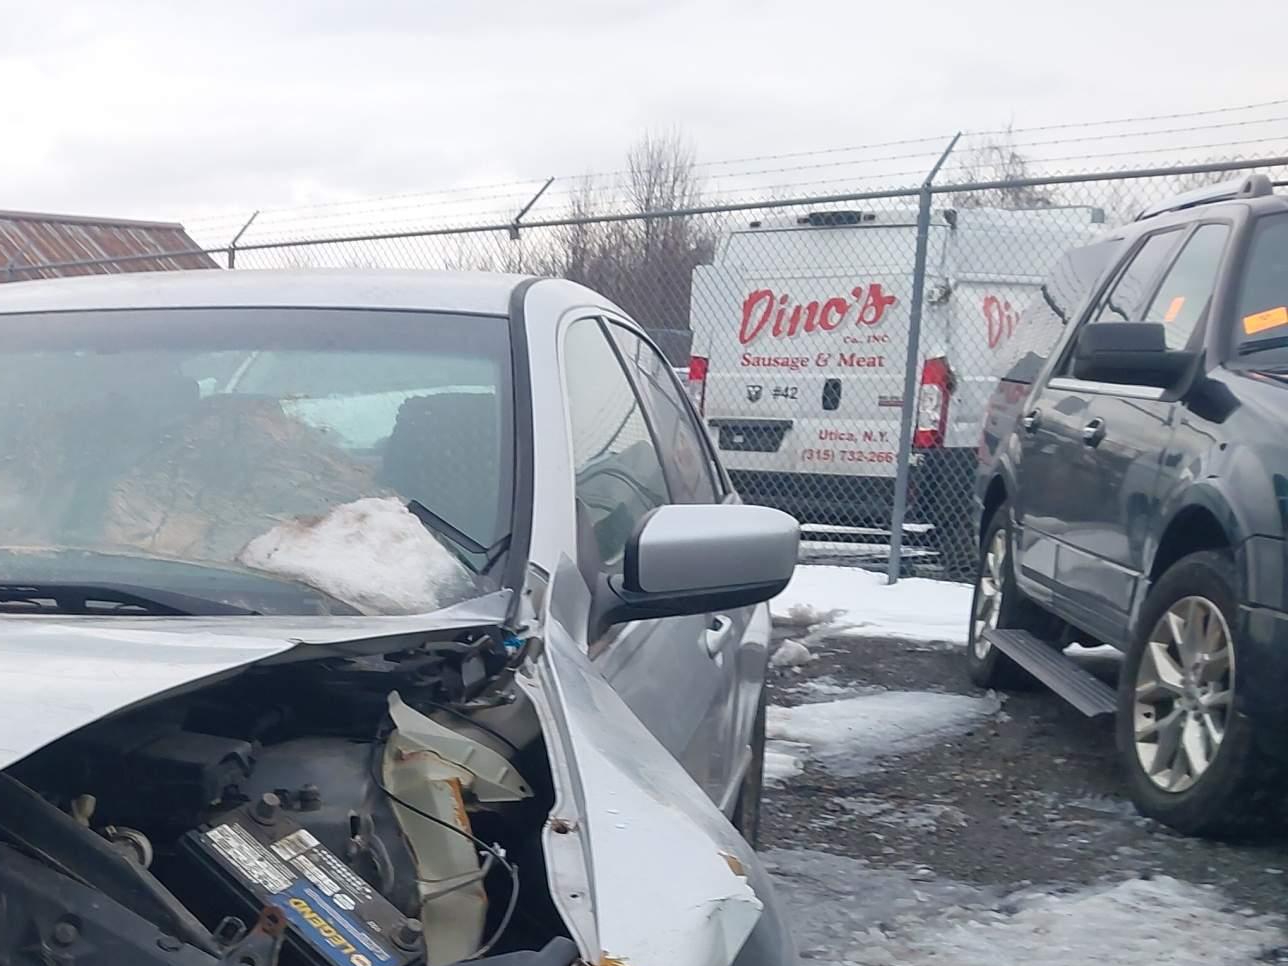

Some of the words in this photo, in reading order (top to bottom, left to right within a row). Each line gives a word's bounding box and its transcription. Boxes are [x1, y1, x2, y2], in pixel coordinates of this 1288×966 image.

[739, 282, 897, 345] Dino's
[741, 352, 809, 370] Sausage
[815, 353, 831, 367] &
[837, 353, 885, 367] Meat
[771, 387, 798, 399] #42
[818, 430, 858, 443] Utica,
[863, 431, 889, 442] N.Y.
[800, 449, 836, 462] (315)
[839, 450, 898, 464] 732-266
[289, 898, 357, 955] LEGEND
